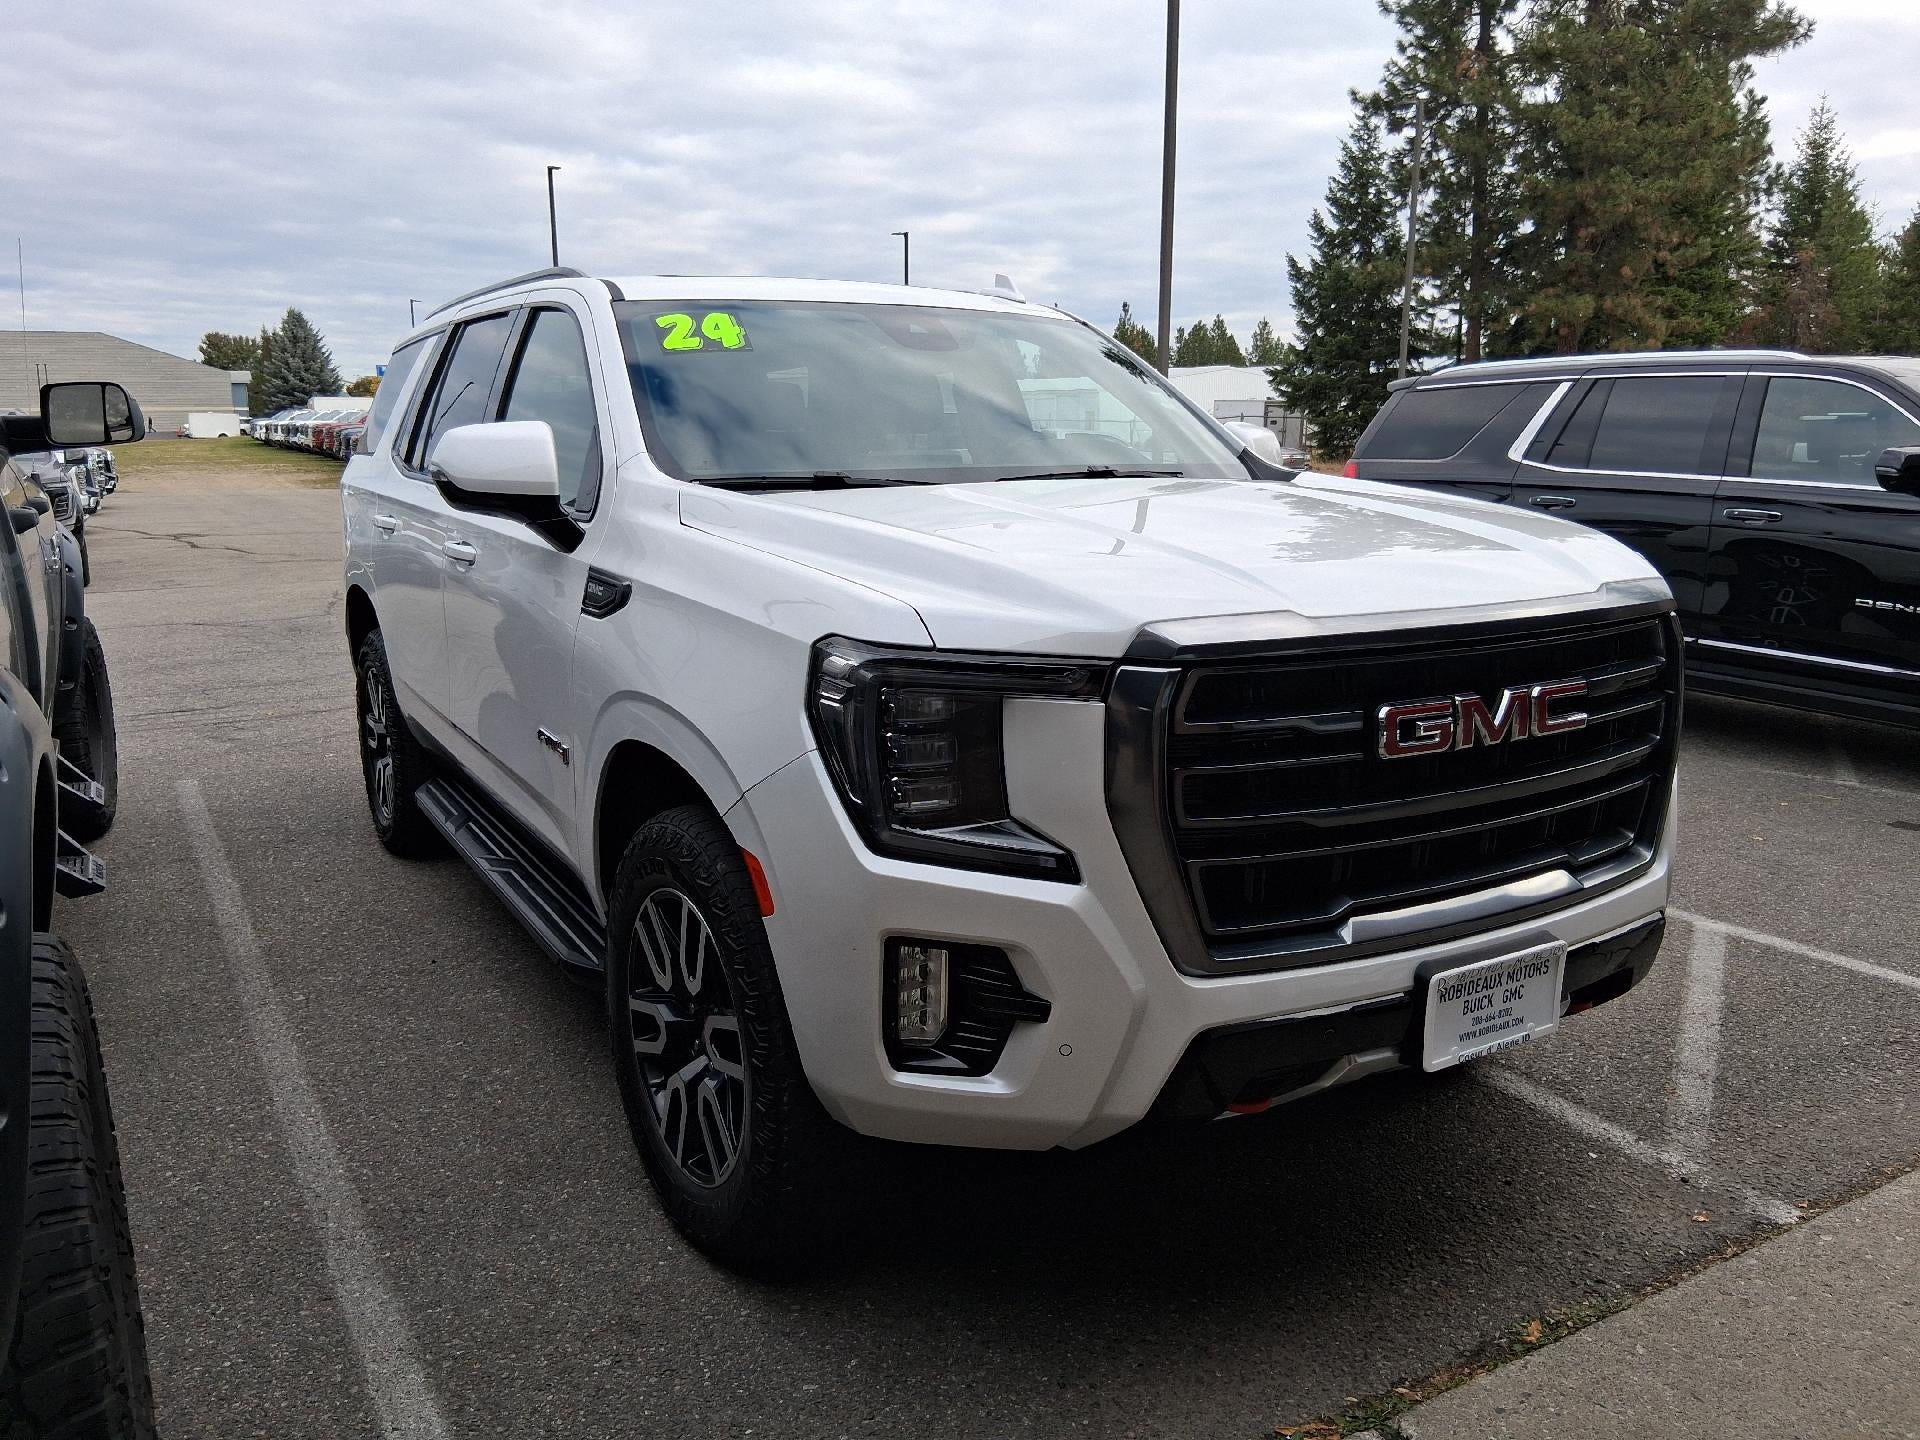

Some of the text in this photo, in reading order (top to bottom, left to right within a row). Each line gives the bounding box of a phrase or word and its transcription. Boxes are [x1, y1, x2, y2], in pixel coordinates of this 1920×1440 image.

[655, 312, 746, 351] 24
[1855, 598, 1920, 614] DEN
[1376, 676, 1589, 760] GMC
[1440, 958, 1550, 1004] ROBIDEAUX MOTORS
[1462, 985, 1525, 1016] BUICK GMC
[1458, 1015, 1525, 1043] WWW.ROBIDEAUX.COM
[1496, 1038, 1520, 1052] Alene
[1521, 1033, 1531, 1044] ID
